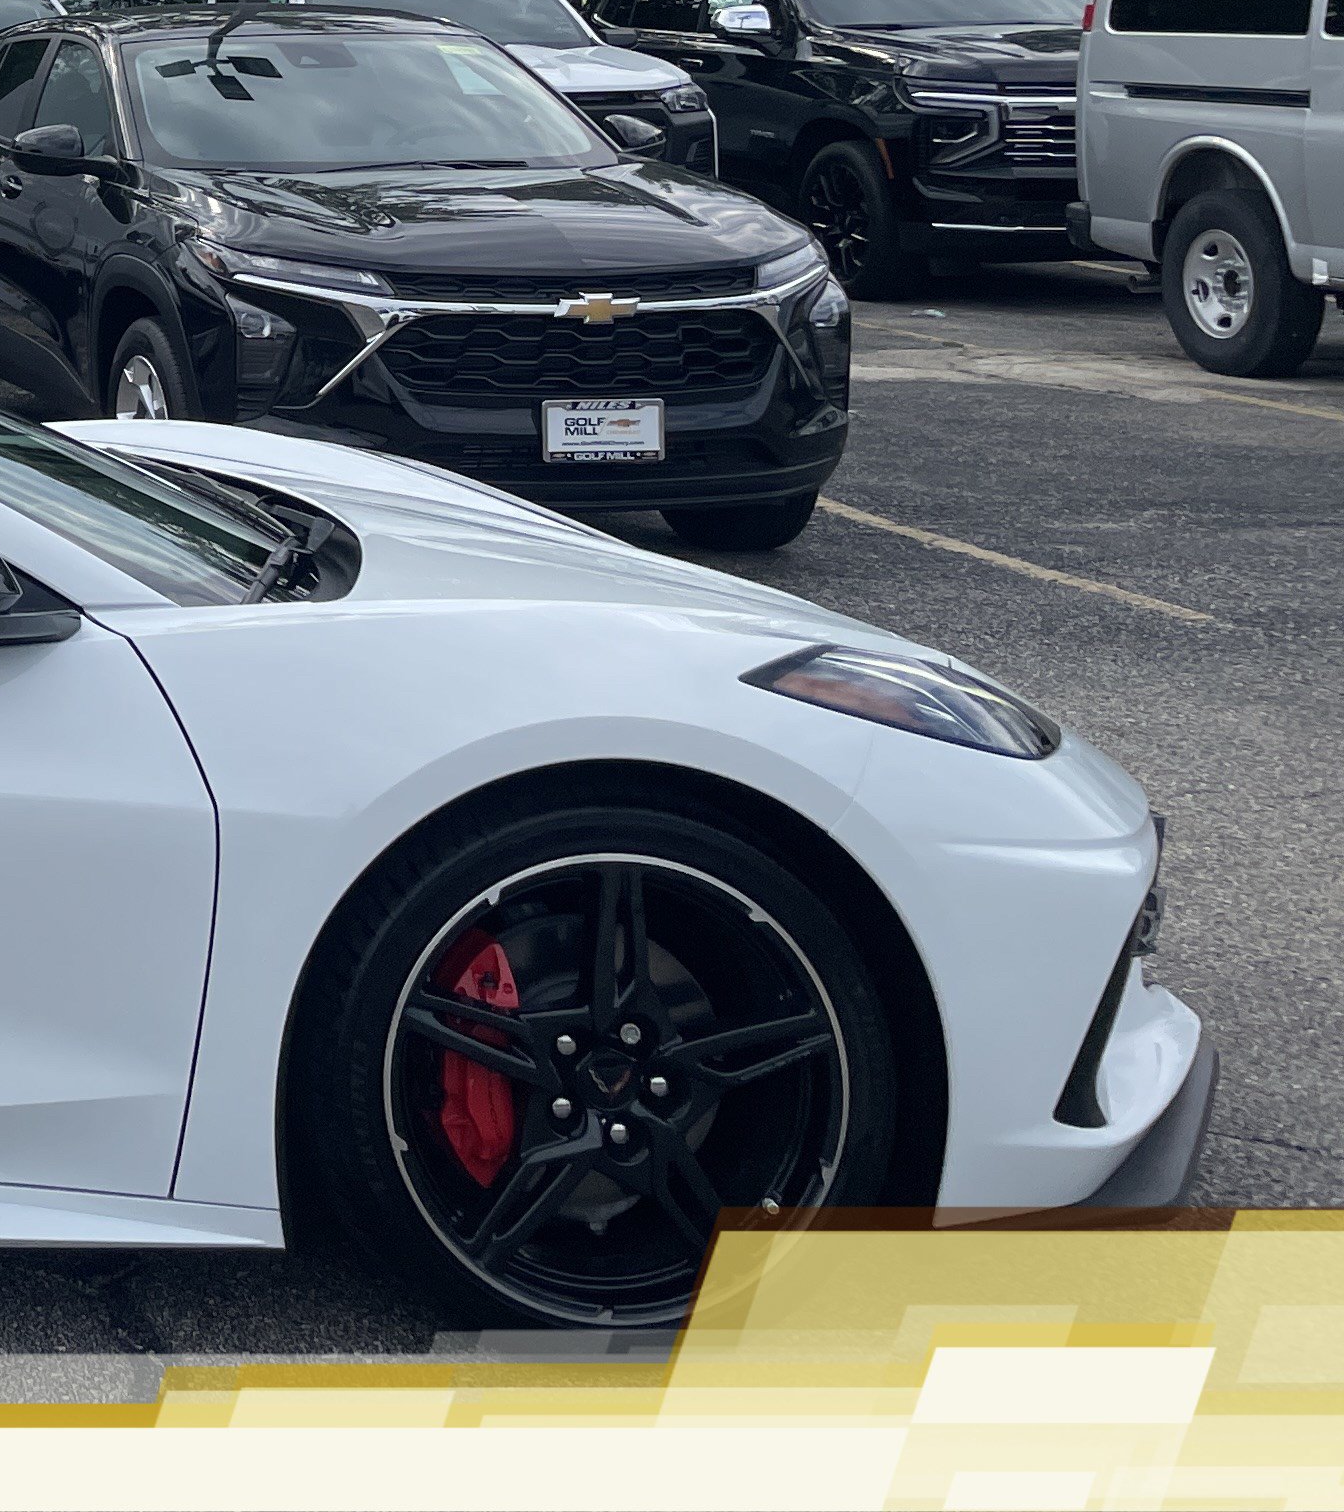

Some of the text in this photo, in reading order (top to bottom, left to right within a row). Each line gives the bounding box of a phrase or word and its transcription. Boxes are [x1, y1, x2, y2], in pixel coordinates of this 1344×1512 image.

[575, 400, 632, 410] NILES
[564, 417, 606, 427] GOLF
[564, 427, 598, 436] MILL
[573, 451, 635, 461] GOLF MILL
